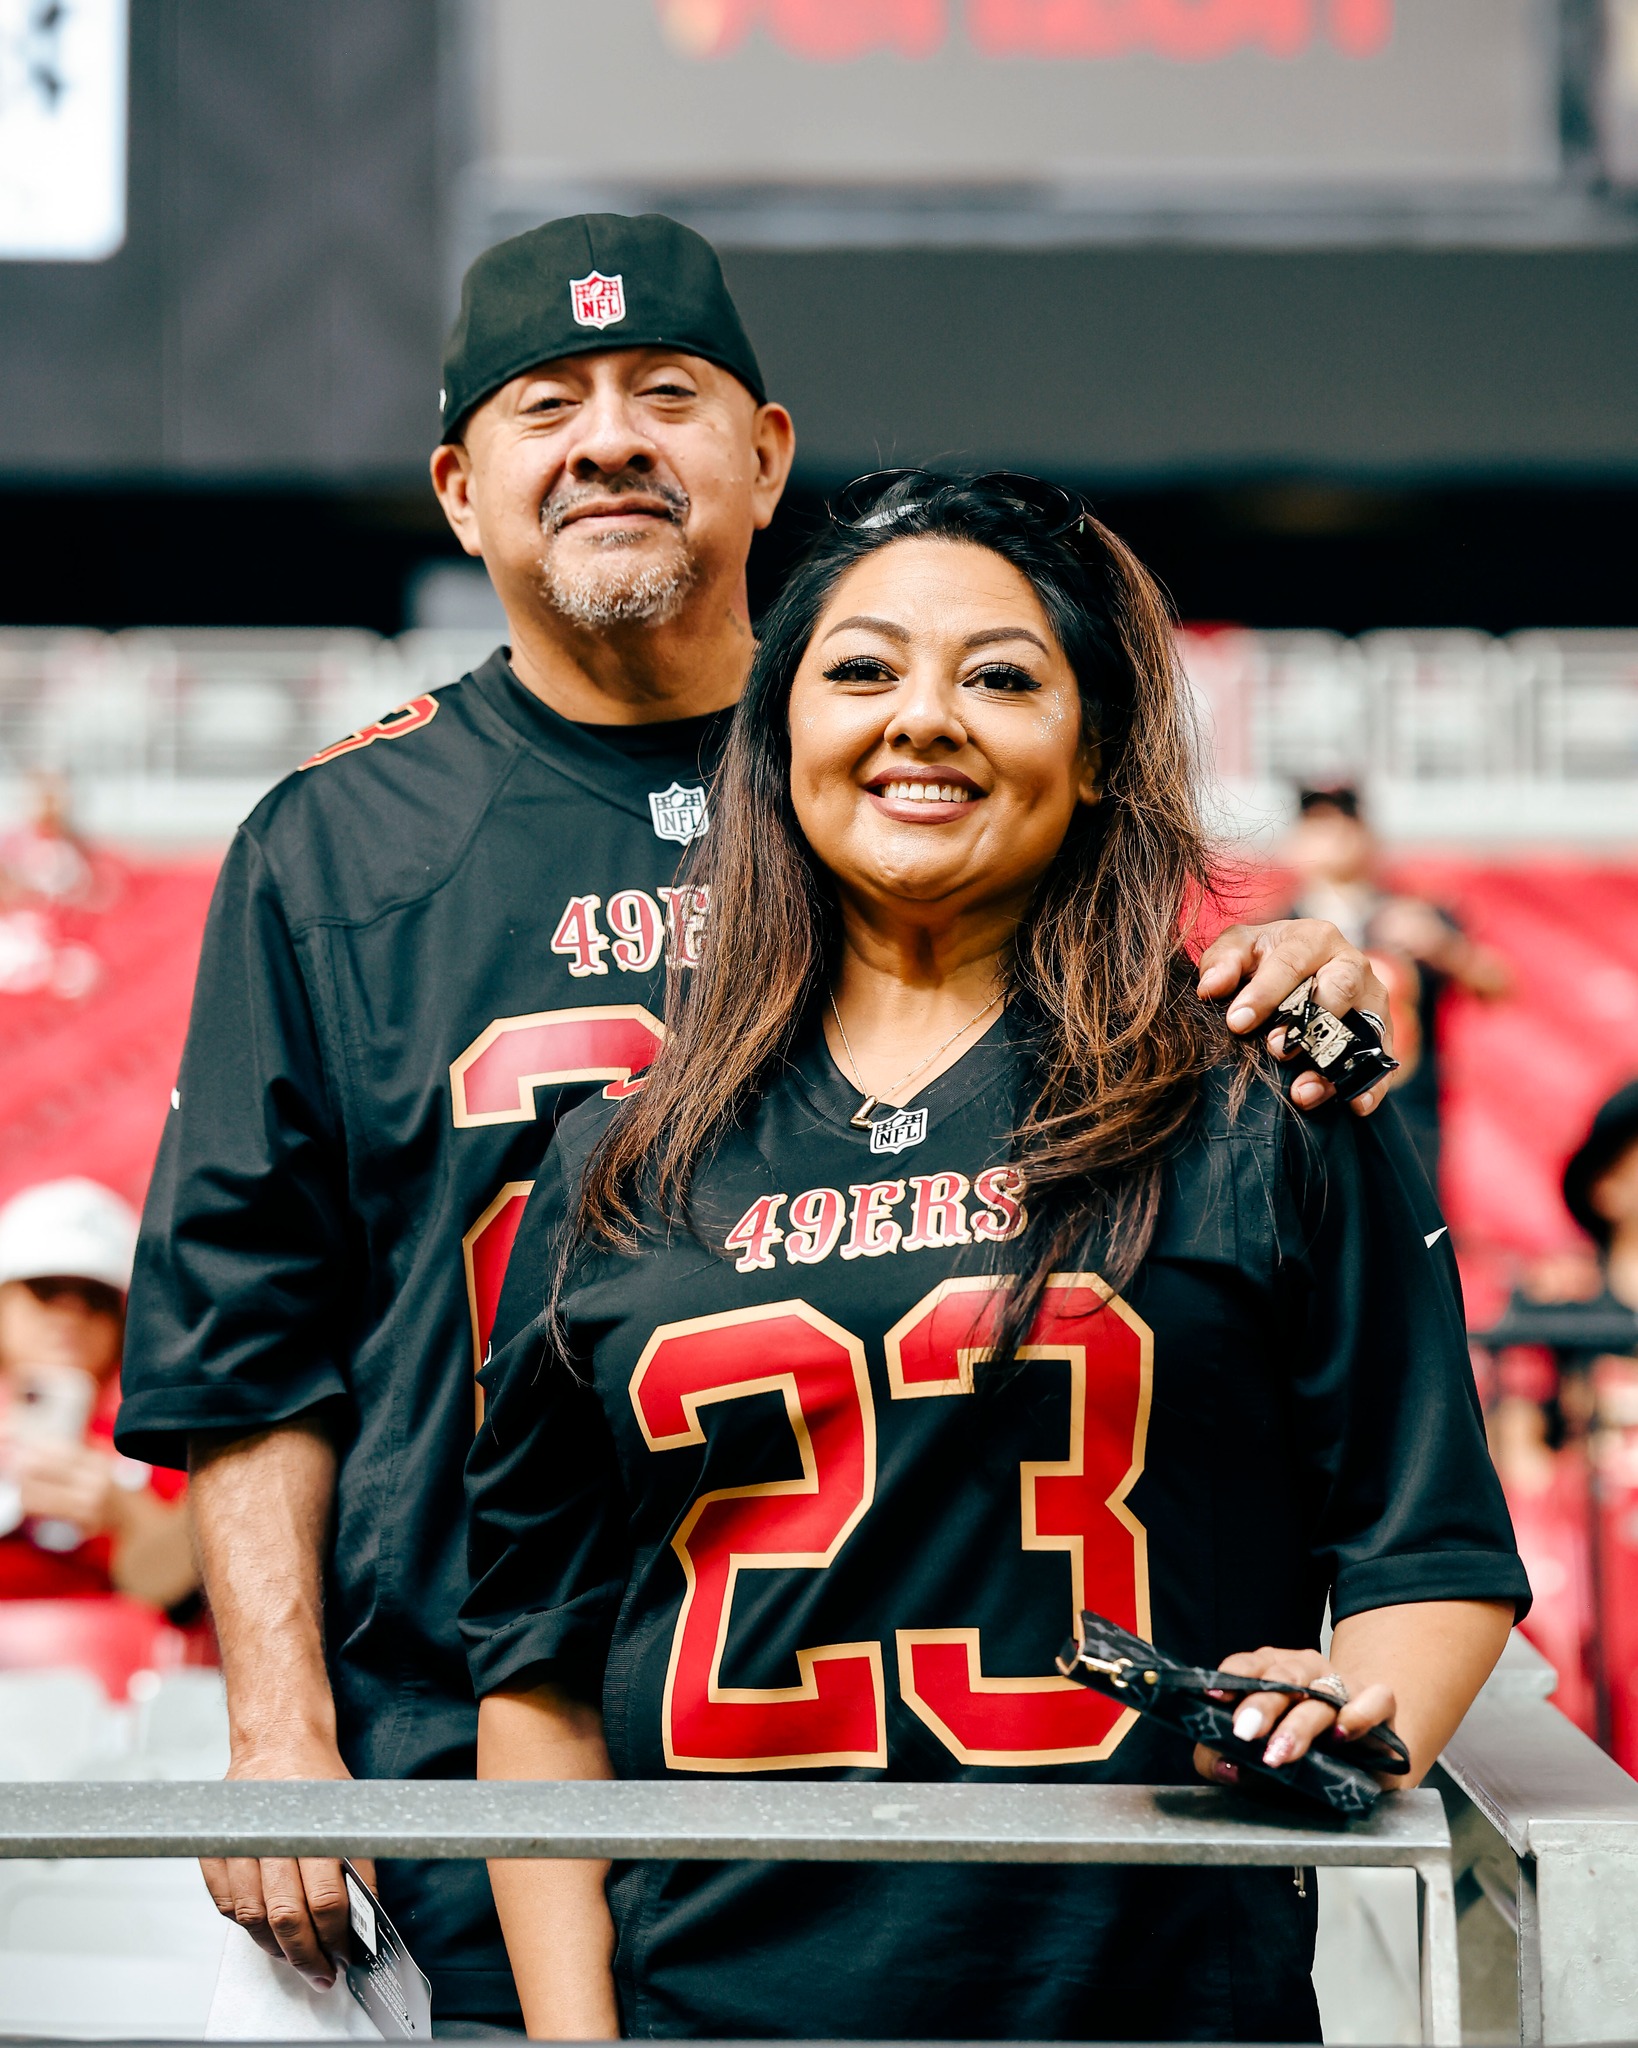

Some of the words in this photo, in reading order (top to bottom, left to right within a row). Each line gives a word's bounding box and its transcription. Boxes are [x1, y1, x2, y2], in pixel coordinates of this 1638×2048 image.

[582, 298, 618, 319] NFL
[662, 809, 700, 833] NFL
[550, 883, 711, 978] 49E
[879, 1125, 917, 1147] NFL
[724, 1166, 1029, 1274] 49ERS
[628, 1272, 1154, 1770] 23
